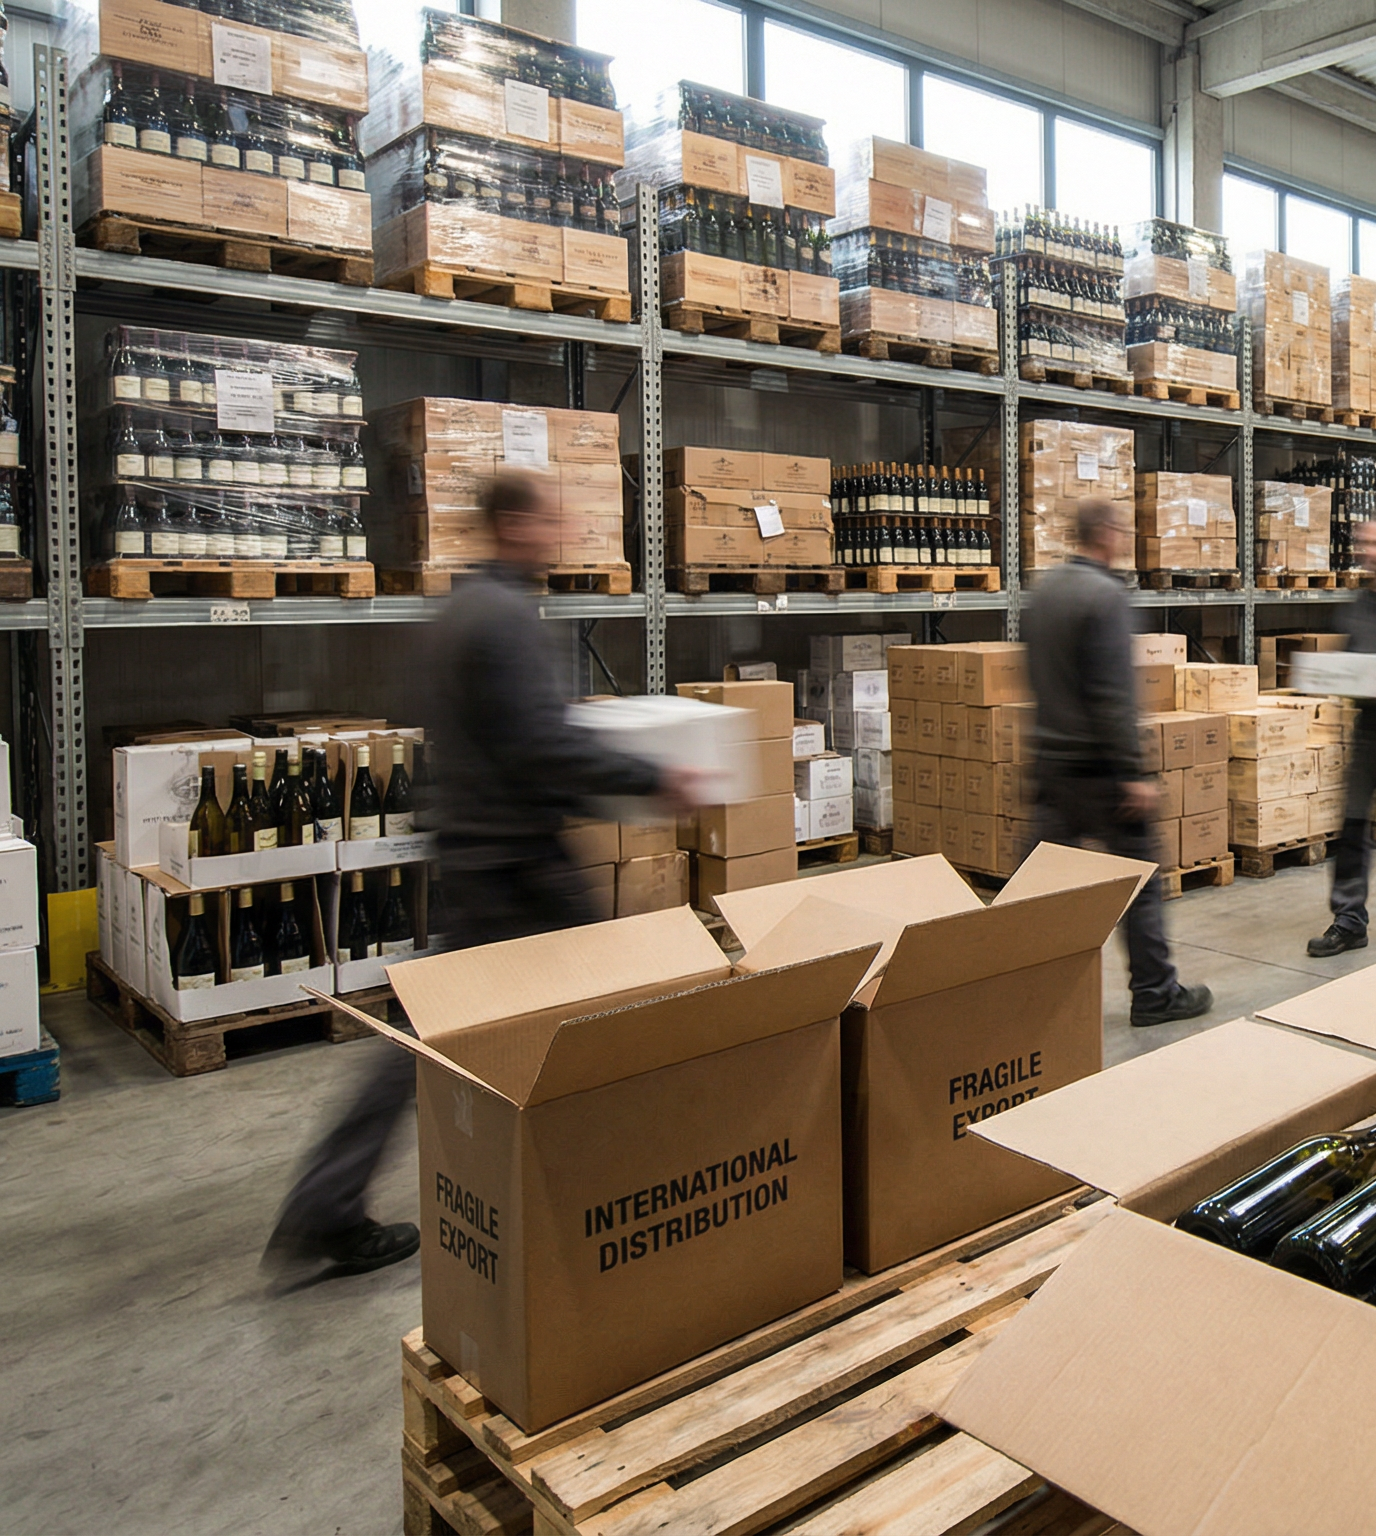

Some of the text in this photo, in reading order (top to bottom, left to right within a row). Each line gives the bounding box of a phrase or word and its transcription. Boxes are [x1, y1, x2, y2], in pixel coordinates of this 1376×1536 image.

[949, 1050, 1043, 1105] FRAGILE
[436, 1170, 499, 1242] FRAGILE
[584, 1137, 798, 1239] INTERNATIONAL
[599, 1174, 789, 1274] DISTRIBUTION
[439, 1216, 498, 1286] EXPORT
